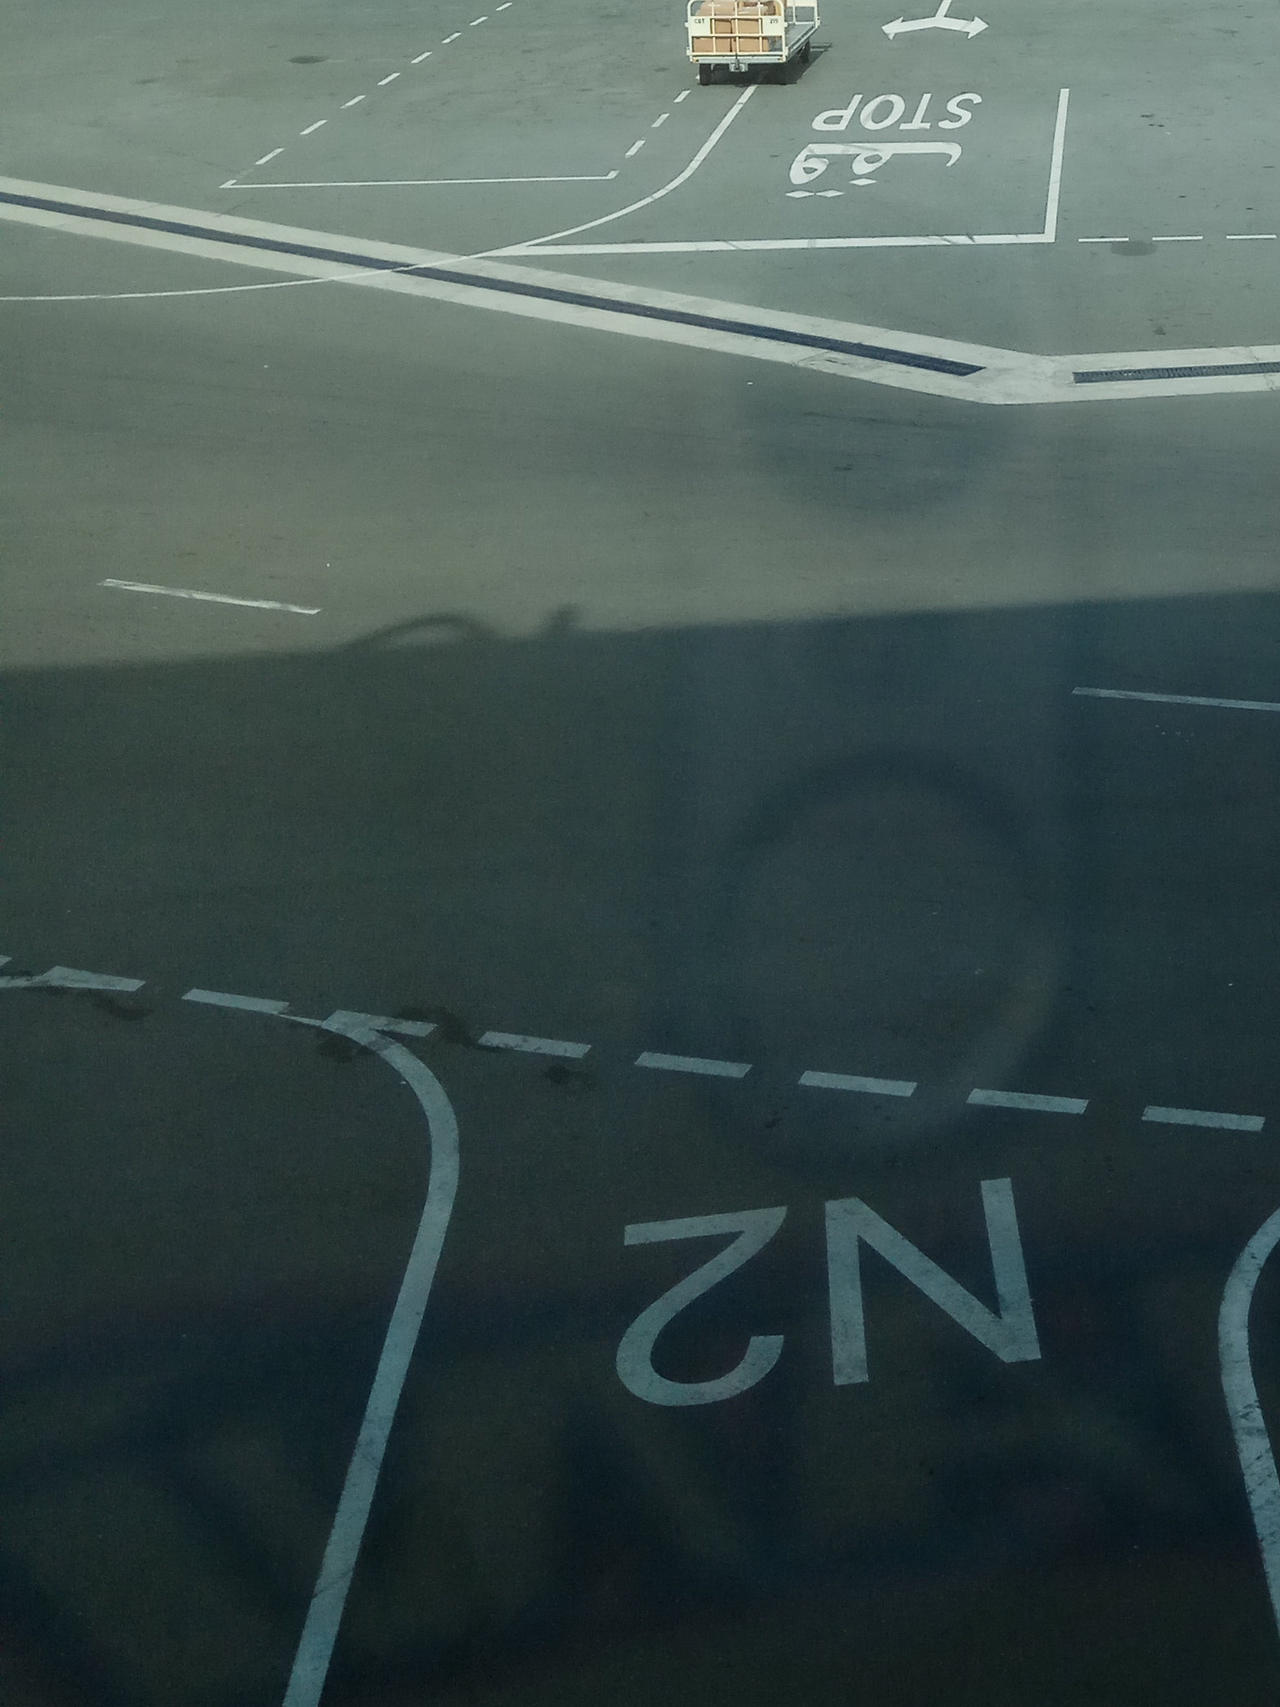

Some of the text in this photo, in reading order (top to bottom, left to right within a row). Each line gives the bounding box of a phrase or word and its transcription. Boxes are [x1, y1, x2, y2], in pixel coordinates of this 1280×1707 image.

[811, 92, 983, 131] STOP
[785, 141, 962, 198] قف
[616, 1177, 1041, 1407] N2
